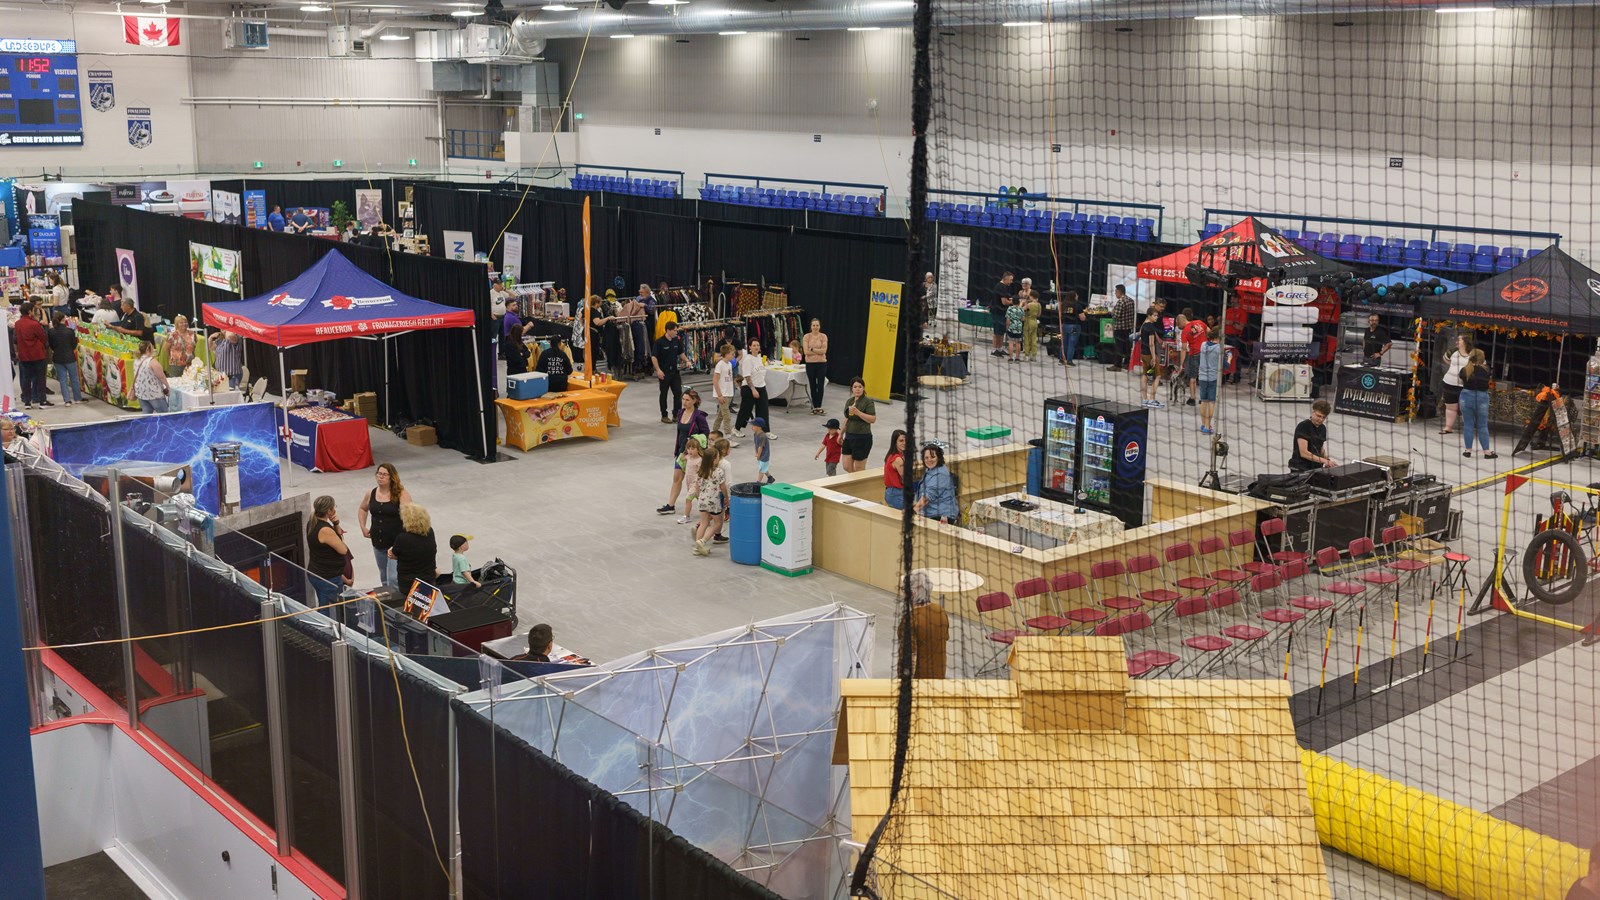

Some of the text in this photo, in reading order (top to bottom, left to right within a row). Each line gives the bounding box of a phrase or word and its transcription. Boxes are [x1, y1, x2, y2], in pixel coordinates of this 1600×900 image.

[20, 58, 50, 72] 11:52
[186, 190, 203, 198] FUJITSU
[1150, 268, 1162, 276] 418
[871, 291, 899, 305] NOUS
[315, 325, 353, 335] BEAUCERON
